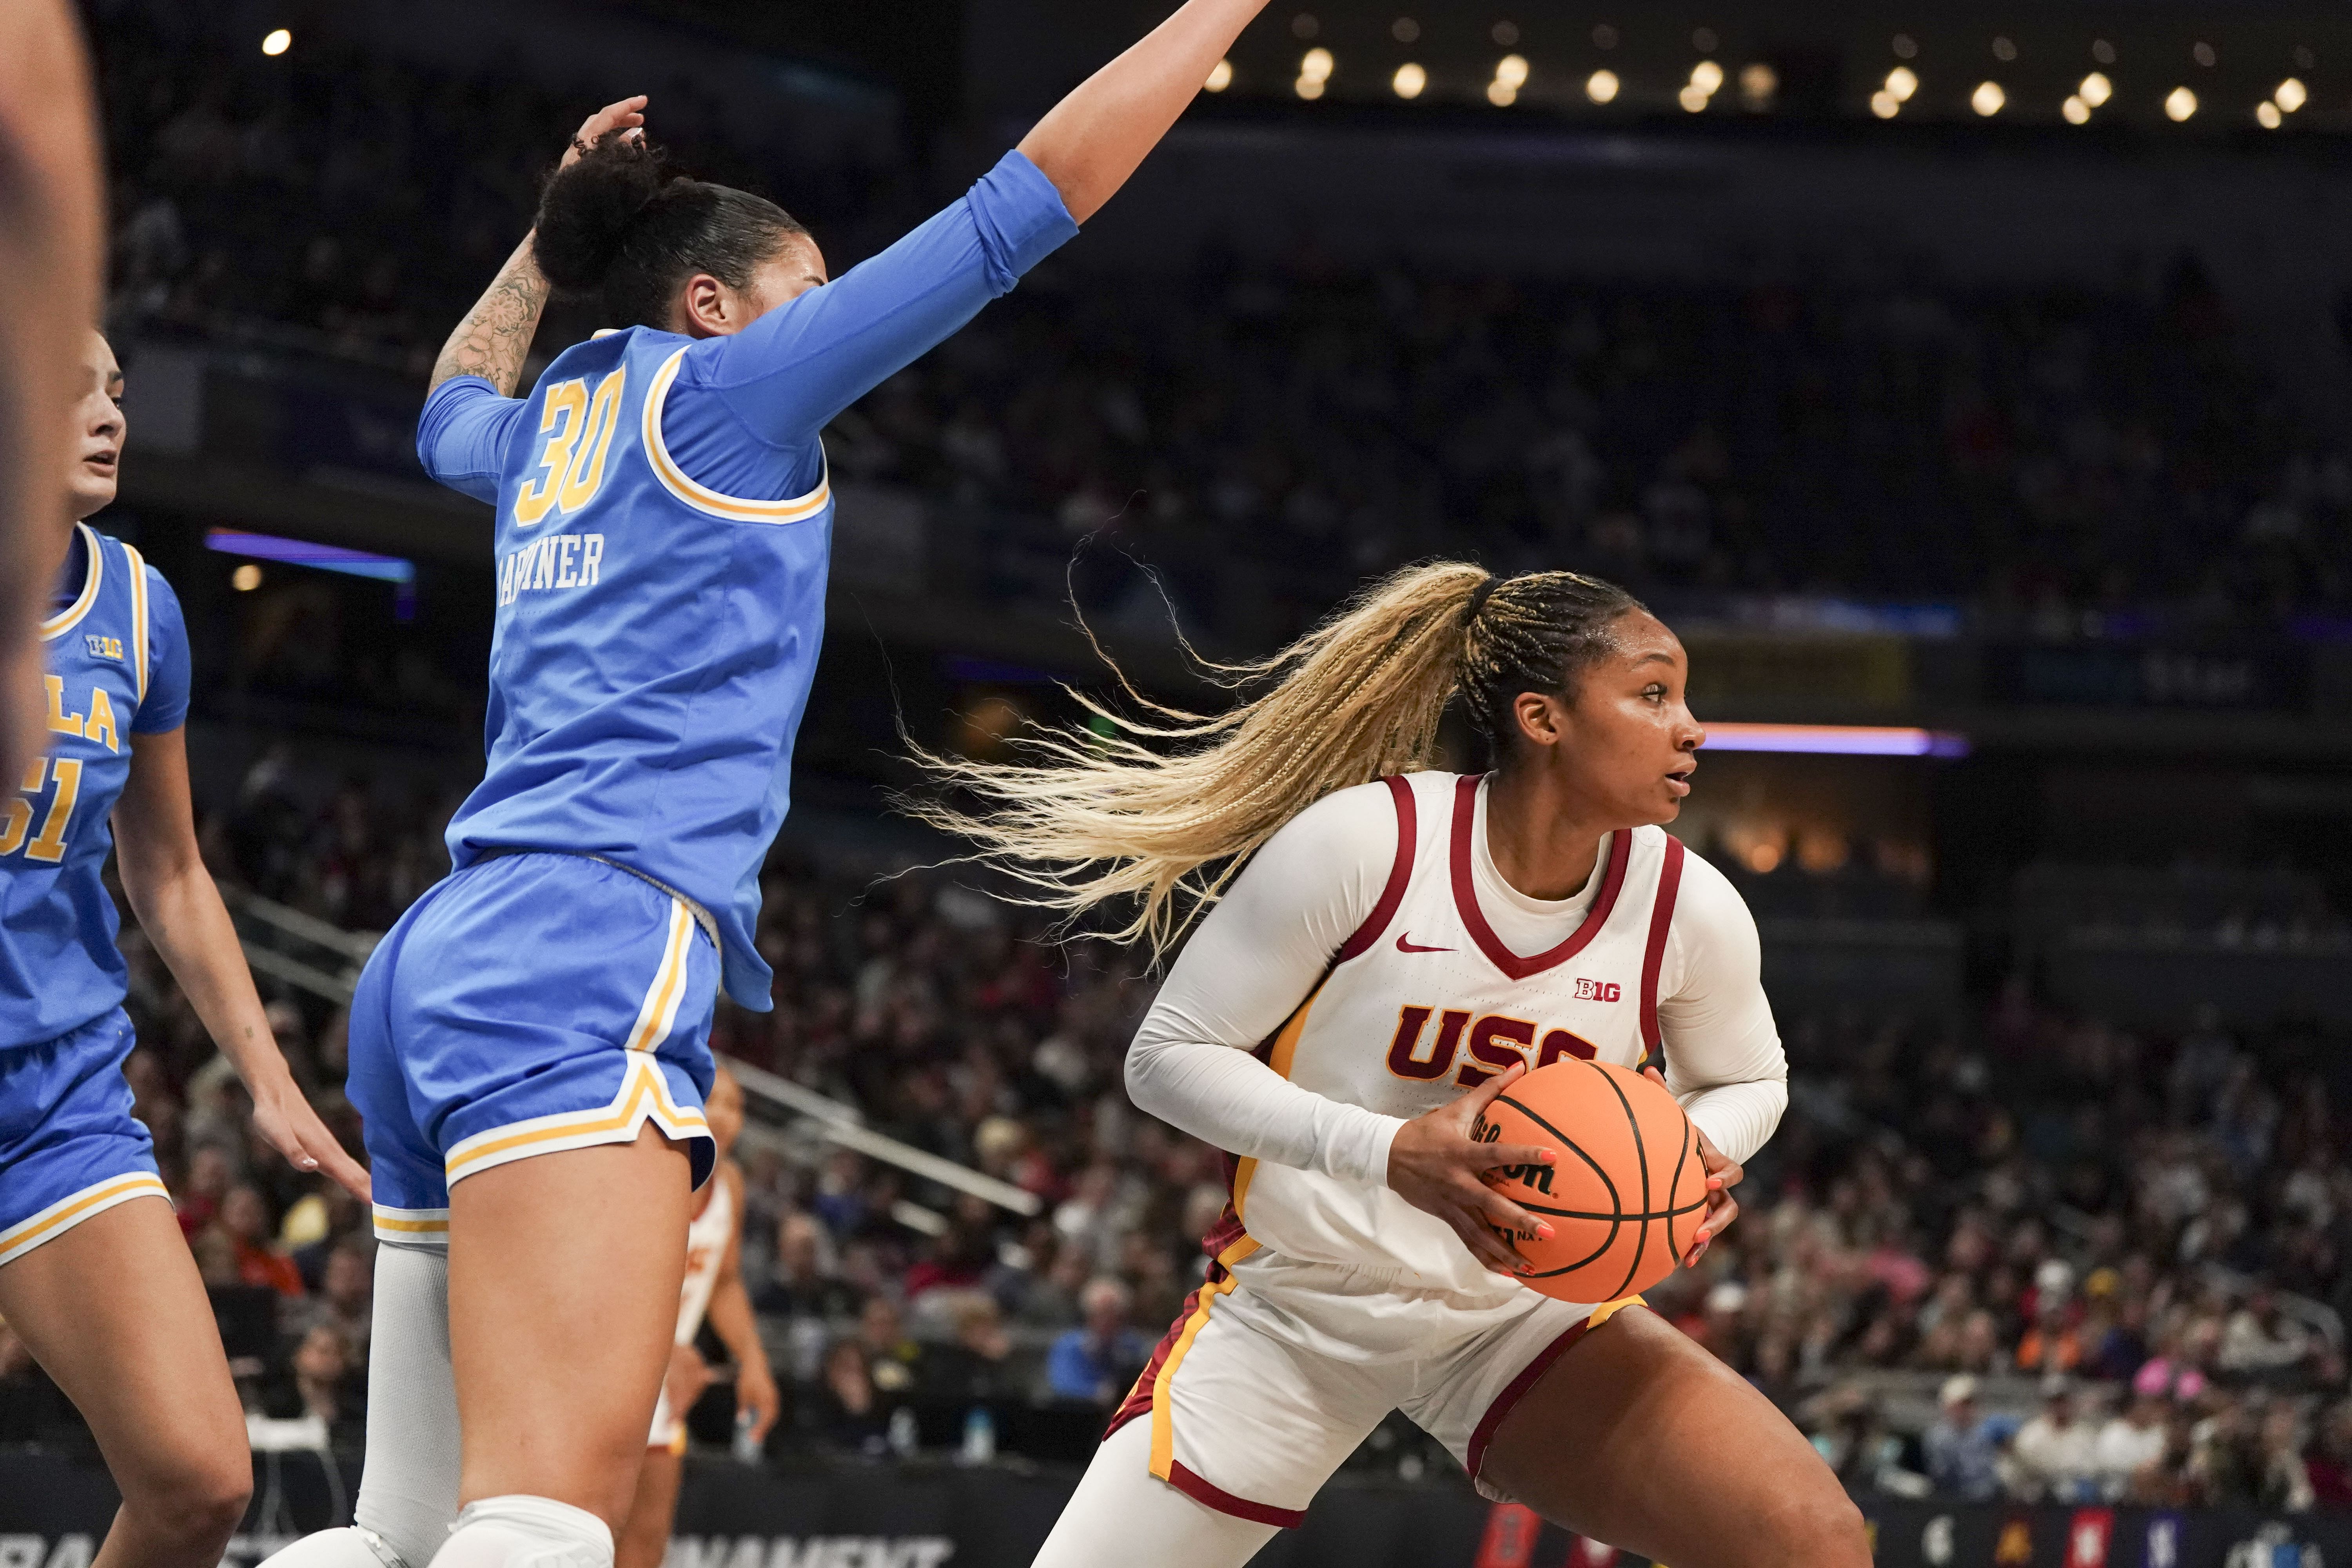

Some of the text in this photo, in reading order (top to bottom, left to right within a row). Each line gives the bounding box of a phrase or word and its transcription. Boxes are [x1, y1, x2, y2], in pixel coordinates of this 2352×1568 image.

[513, 361, 626, 527] 30
[44, 674, 118, 755] LA
[1517, 1230, 1545, 1241] NX
